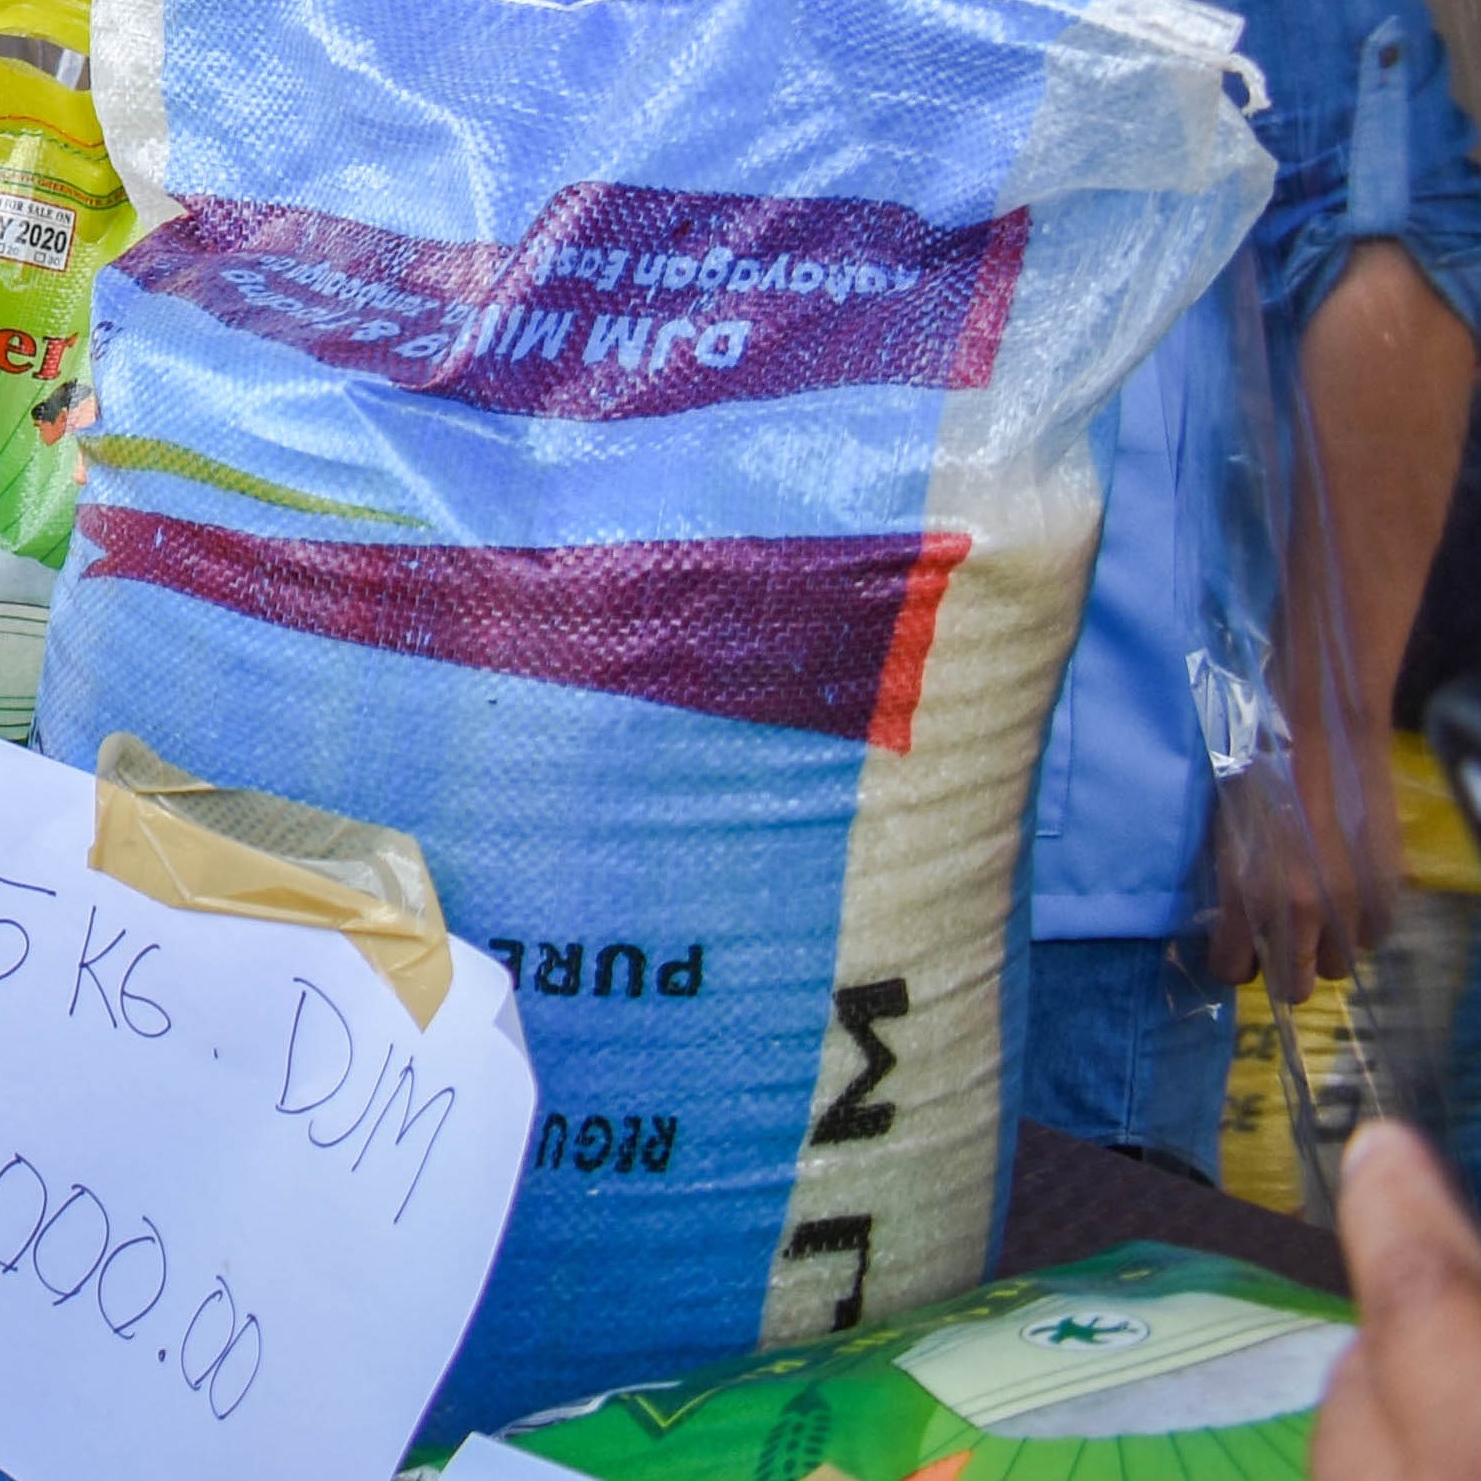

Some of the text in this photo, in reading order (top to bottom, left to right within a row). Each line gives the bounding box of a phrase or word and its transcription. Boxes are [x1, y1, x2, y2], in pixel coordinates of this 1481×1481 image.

[4, 197, 24, 212] FOR
[28, 203, 52, 219] SALE
[55, 210, 71, 224] ON
[15, 220, 68, 254] 2020
[391, 303, 577, 366] Millg
[582, 315, 752, 372] DJM
[274, 976, 457, 1225] DJM
[533, 1112, 678, 1175] REGU
